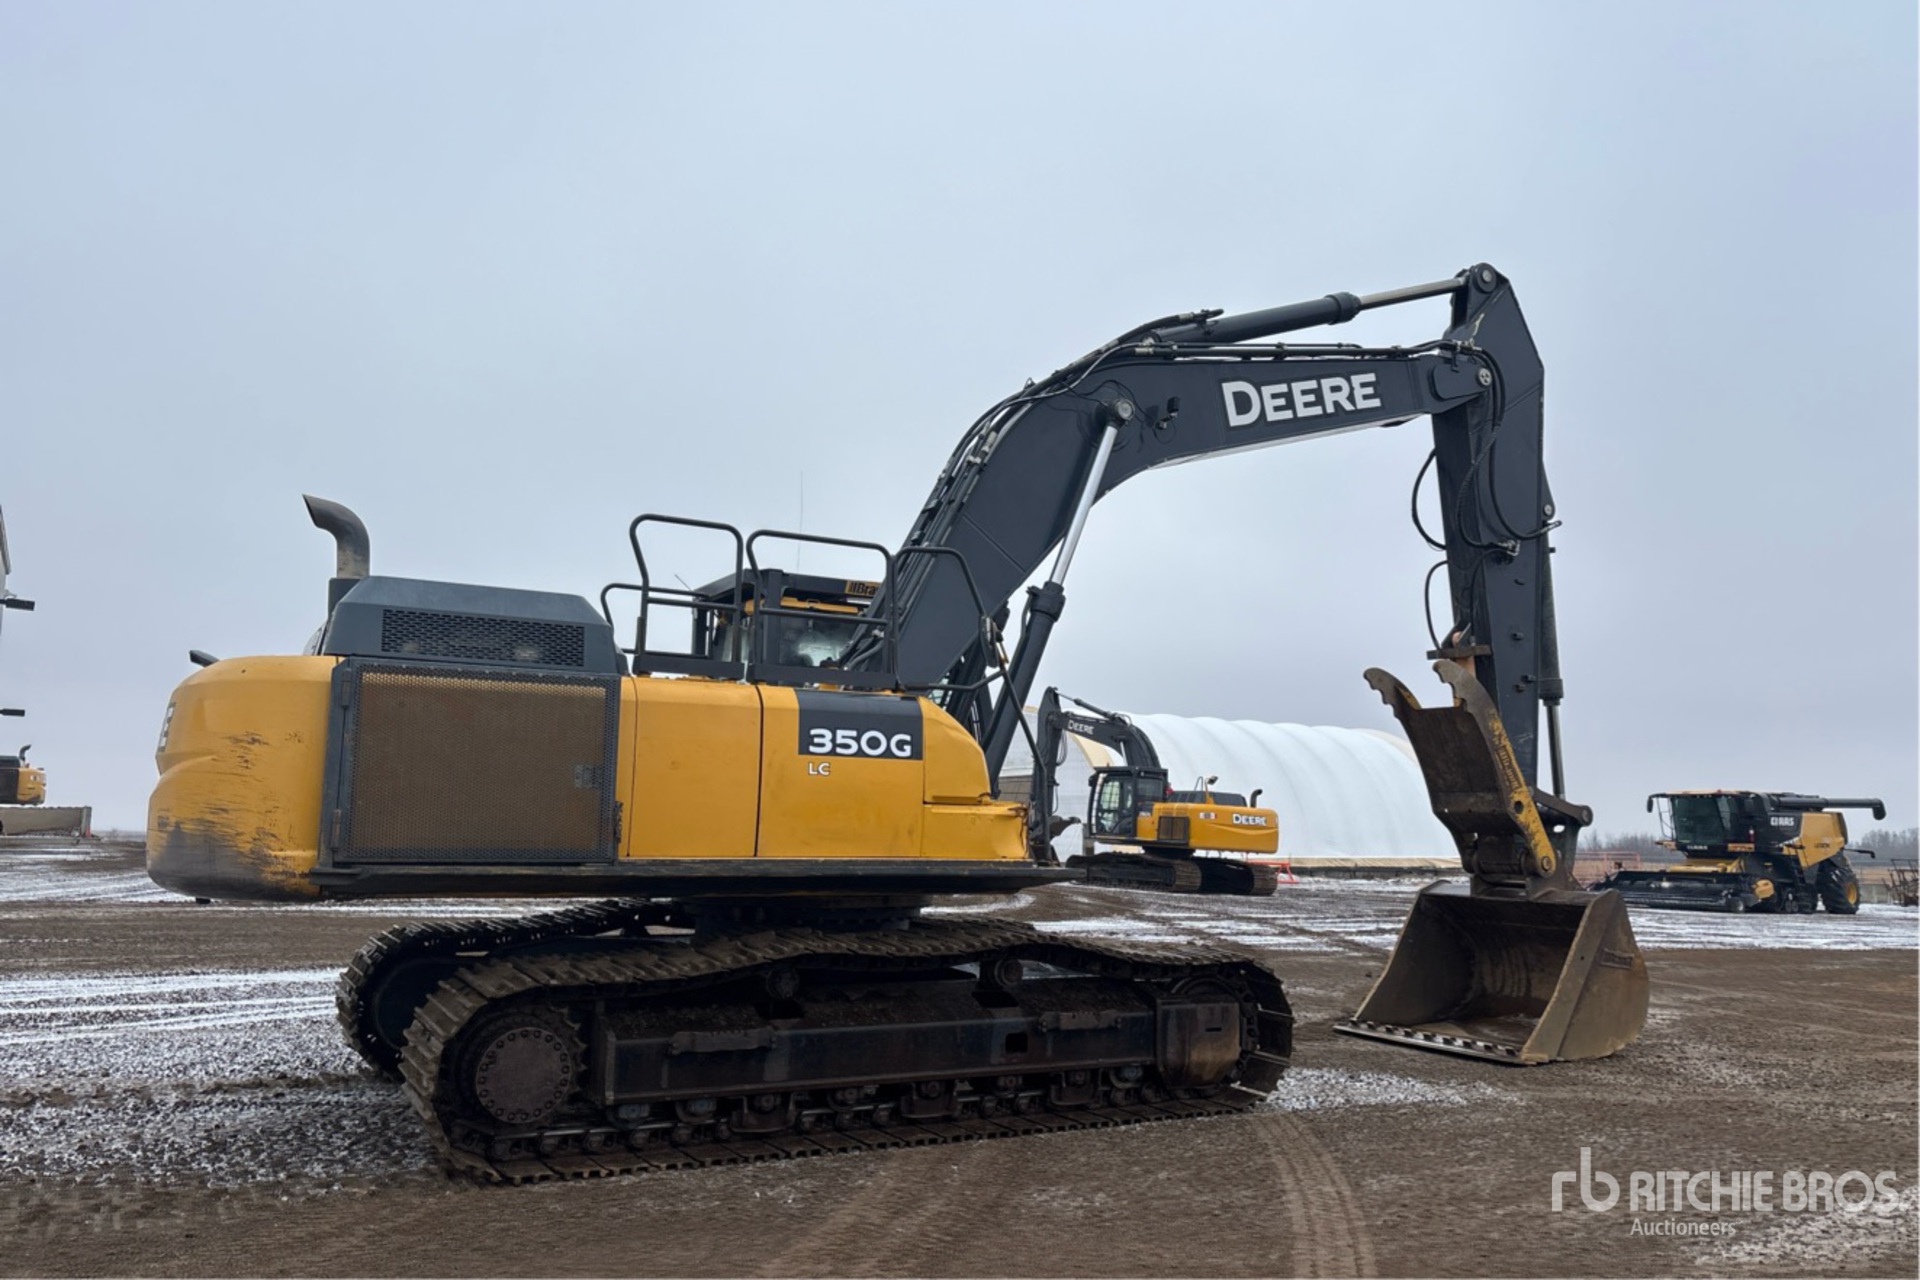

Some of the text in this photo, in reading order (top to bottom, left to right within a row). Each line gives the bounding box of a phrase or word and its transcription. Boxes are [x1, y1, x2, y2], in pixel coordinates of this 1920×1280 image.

[1221, 372, 1382, 427] DEERE
[808, 728, 912, 757] 350G
[808, 762, 830, 775] LC
